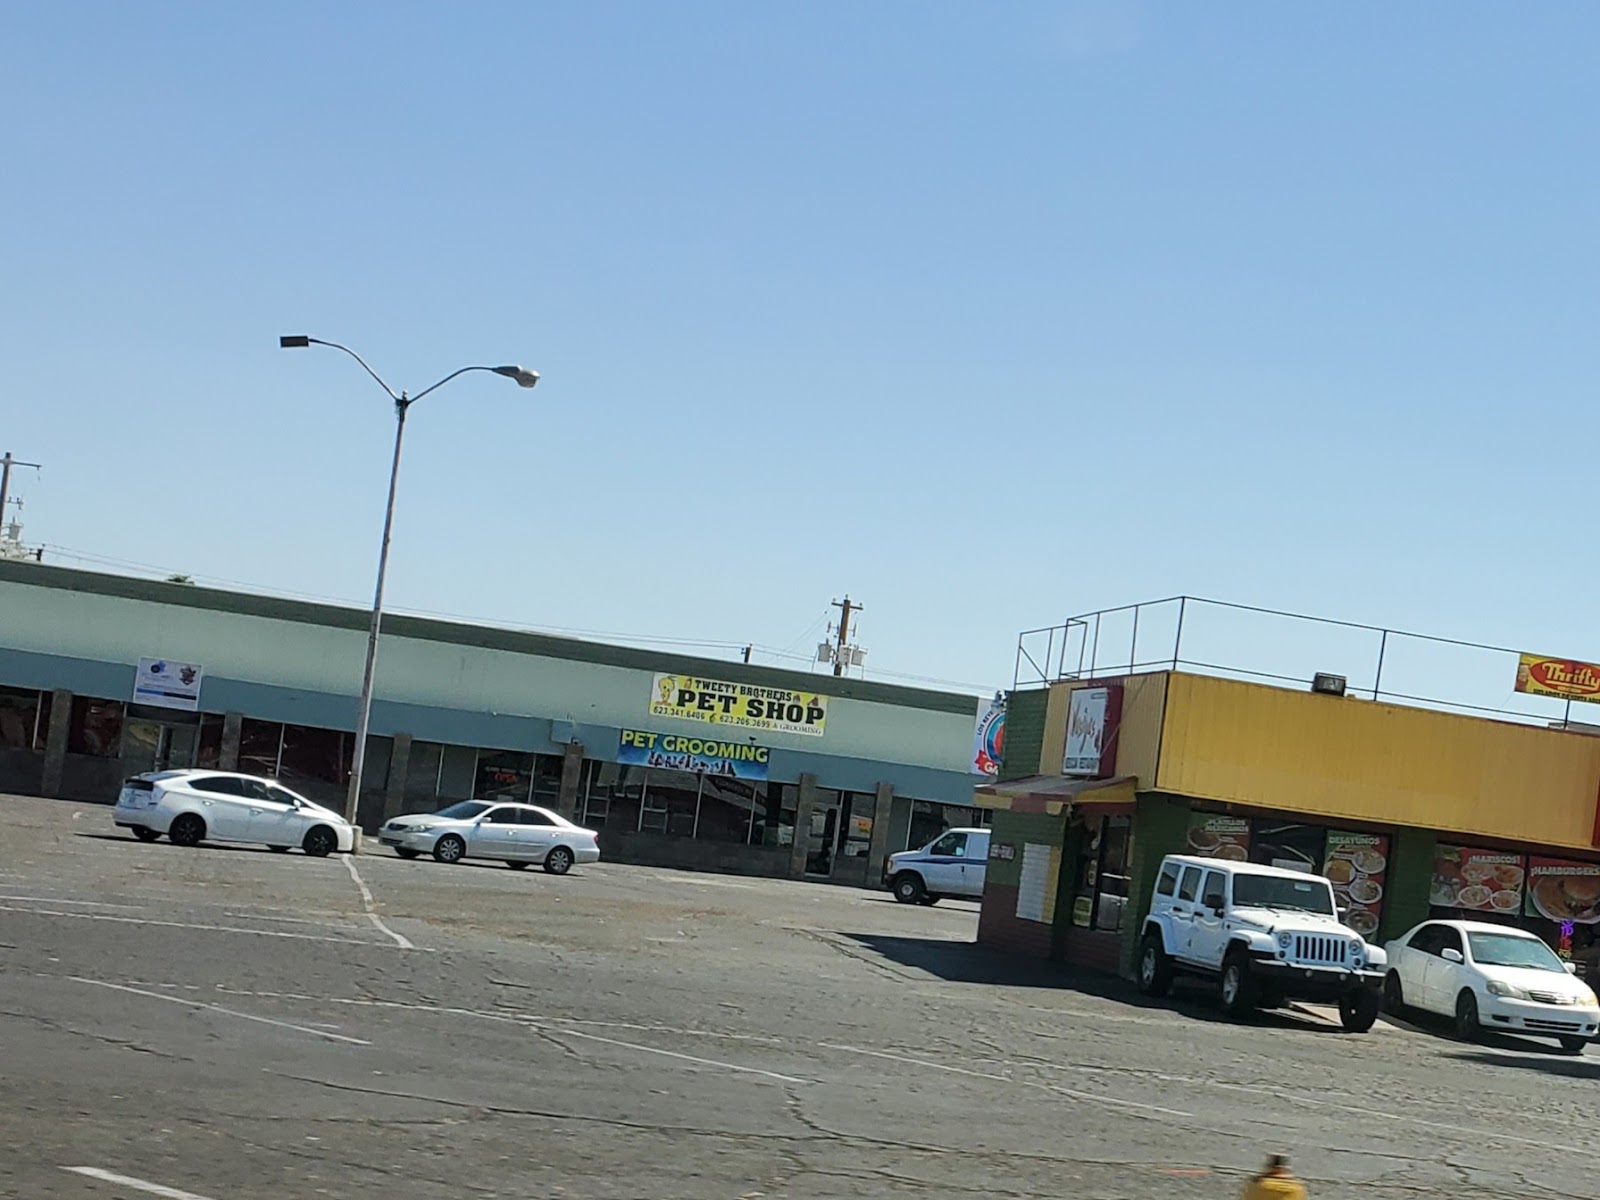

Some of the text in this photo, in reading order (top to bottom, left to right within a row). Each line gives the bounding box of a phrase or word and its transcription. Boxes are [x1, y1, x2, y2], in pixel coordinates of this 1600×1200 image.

[1541, 662, 1600, 691] Thrifty
[694, 679, 792, 701] TWEETY BROTHERS
[676, 689, 825, 725] PET SHOP
[780, 723, 822, 735] GROOMING
[976, 710, 994, 736] LOS REYE
[621, 729, 769, 763] PET GROOMING
[1328, 836, 1380, 845] DESAYUNOS
